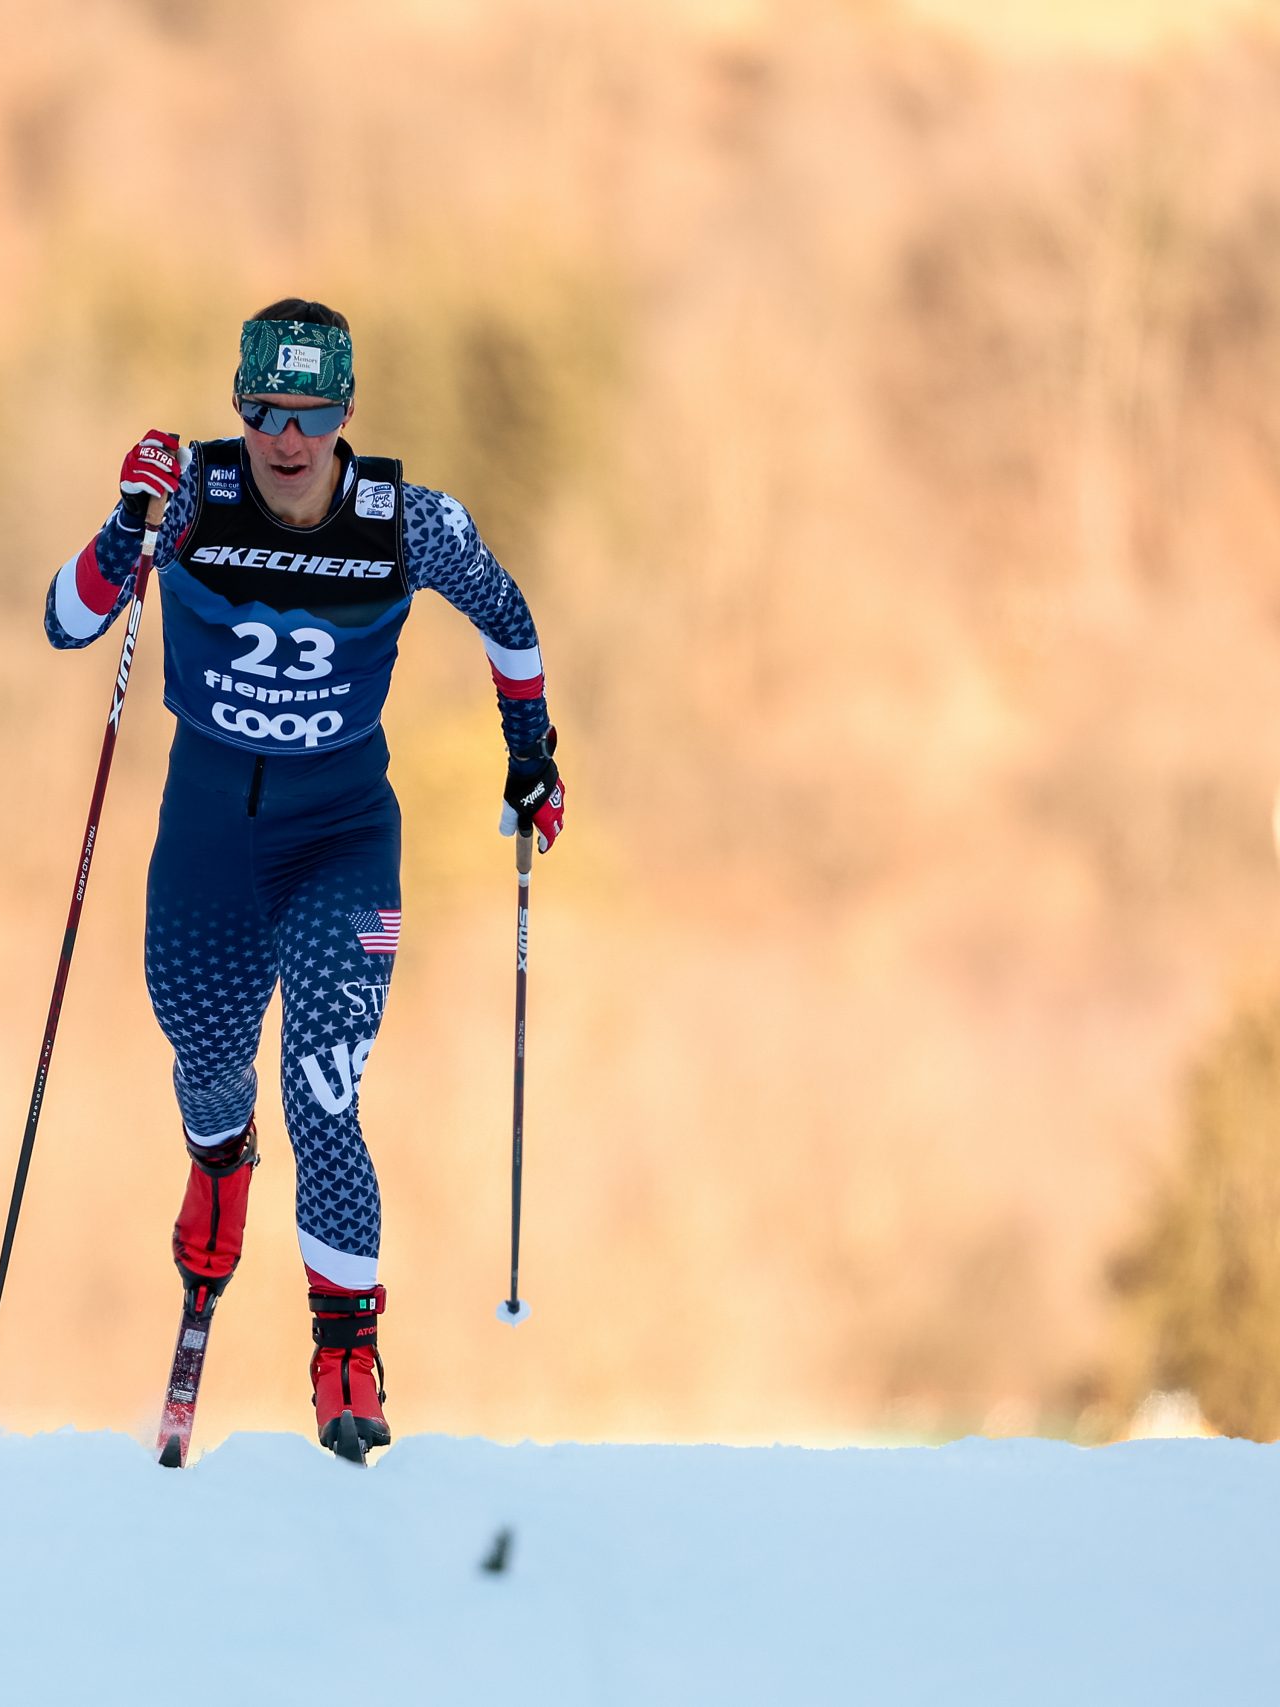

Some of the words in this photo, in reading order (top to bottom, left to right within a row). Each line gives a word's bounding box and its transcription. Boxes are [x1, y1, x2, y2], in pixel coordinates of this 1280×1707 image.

[292, 361, 311, 369] Clinic
[293, 355, 318, 364] Memory
[139, 447, 173, 467] HESTRA
[210, 488, 237, 500] coop
[190, 546, 395, 580] SKECHERS
[230, 621, 336, 681] 23
[211, 701, 344, 748] coop
[85, 825, 96, 856] TRIAC
[356, 1326, 377, 1337] ATO
